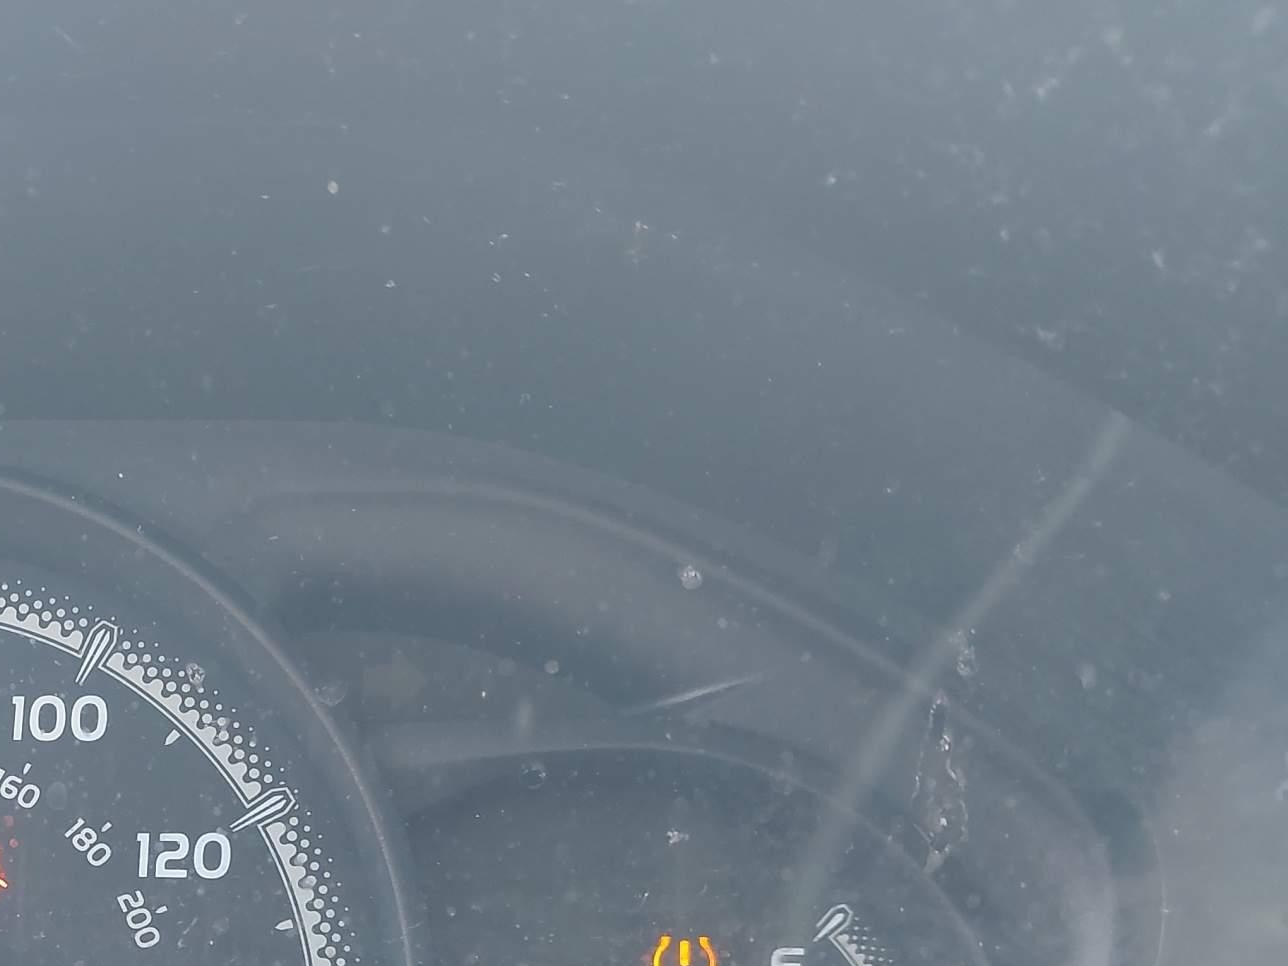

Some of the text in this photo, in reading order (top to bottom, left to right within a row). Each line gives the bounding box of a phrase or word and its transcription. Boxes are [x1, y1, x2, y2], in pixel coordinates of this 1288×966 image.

[12, 695, 108, 741] 100
[64, 817, 112, 867] 180
[136, 832, 231, 879] 120
[117, 890, 160, 948] 200
